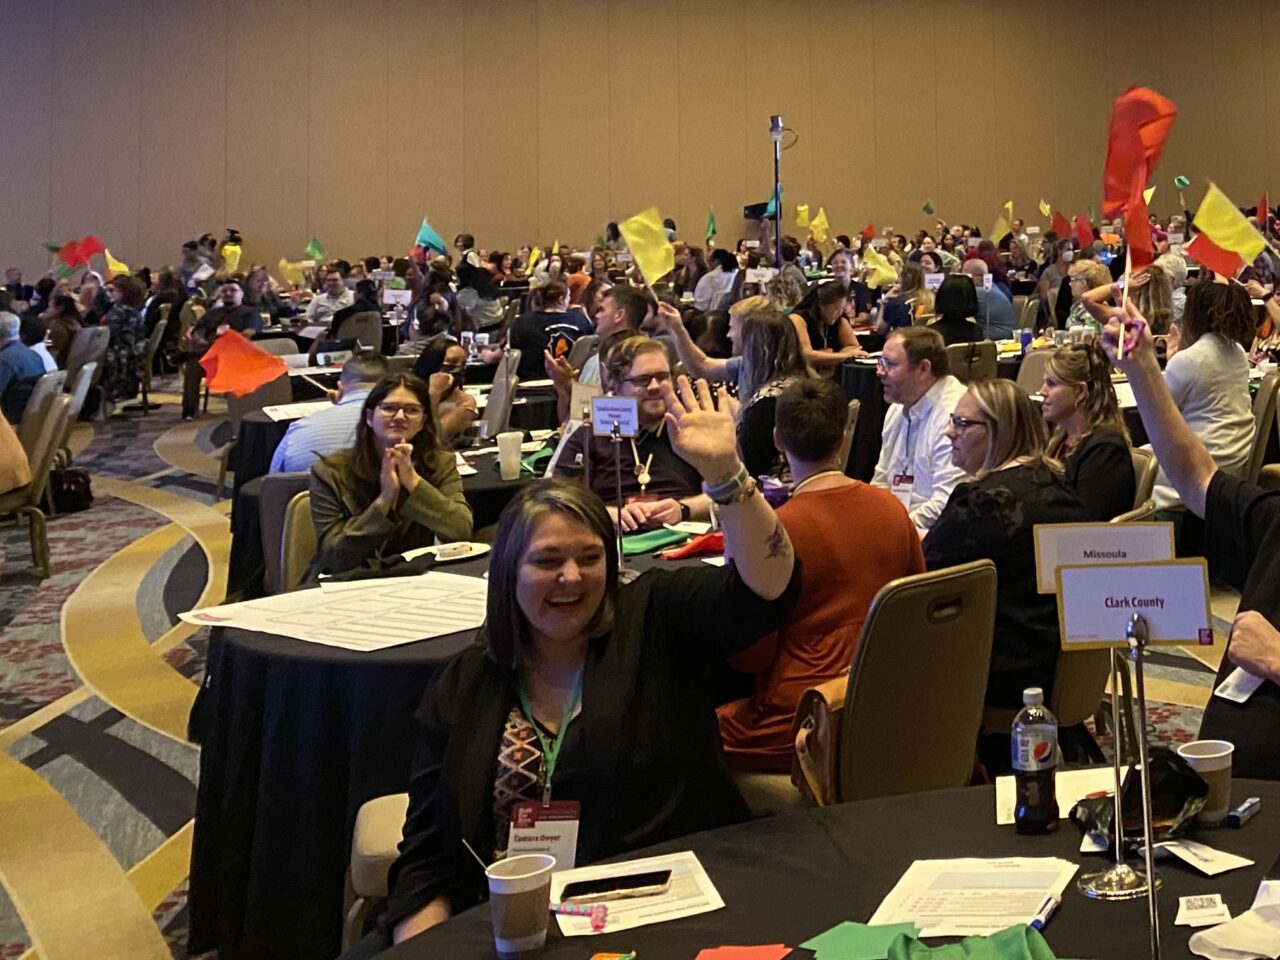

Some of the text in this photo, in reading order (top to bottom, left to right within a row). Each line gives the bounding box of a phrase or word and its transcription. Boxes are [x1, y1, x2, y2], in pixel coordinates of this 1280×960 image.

[1083, 549, 1127, 559] Missoula
[1104, 596, 1165, 610] Clark County
